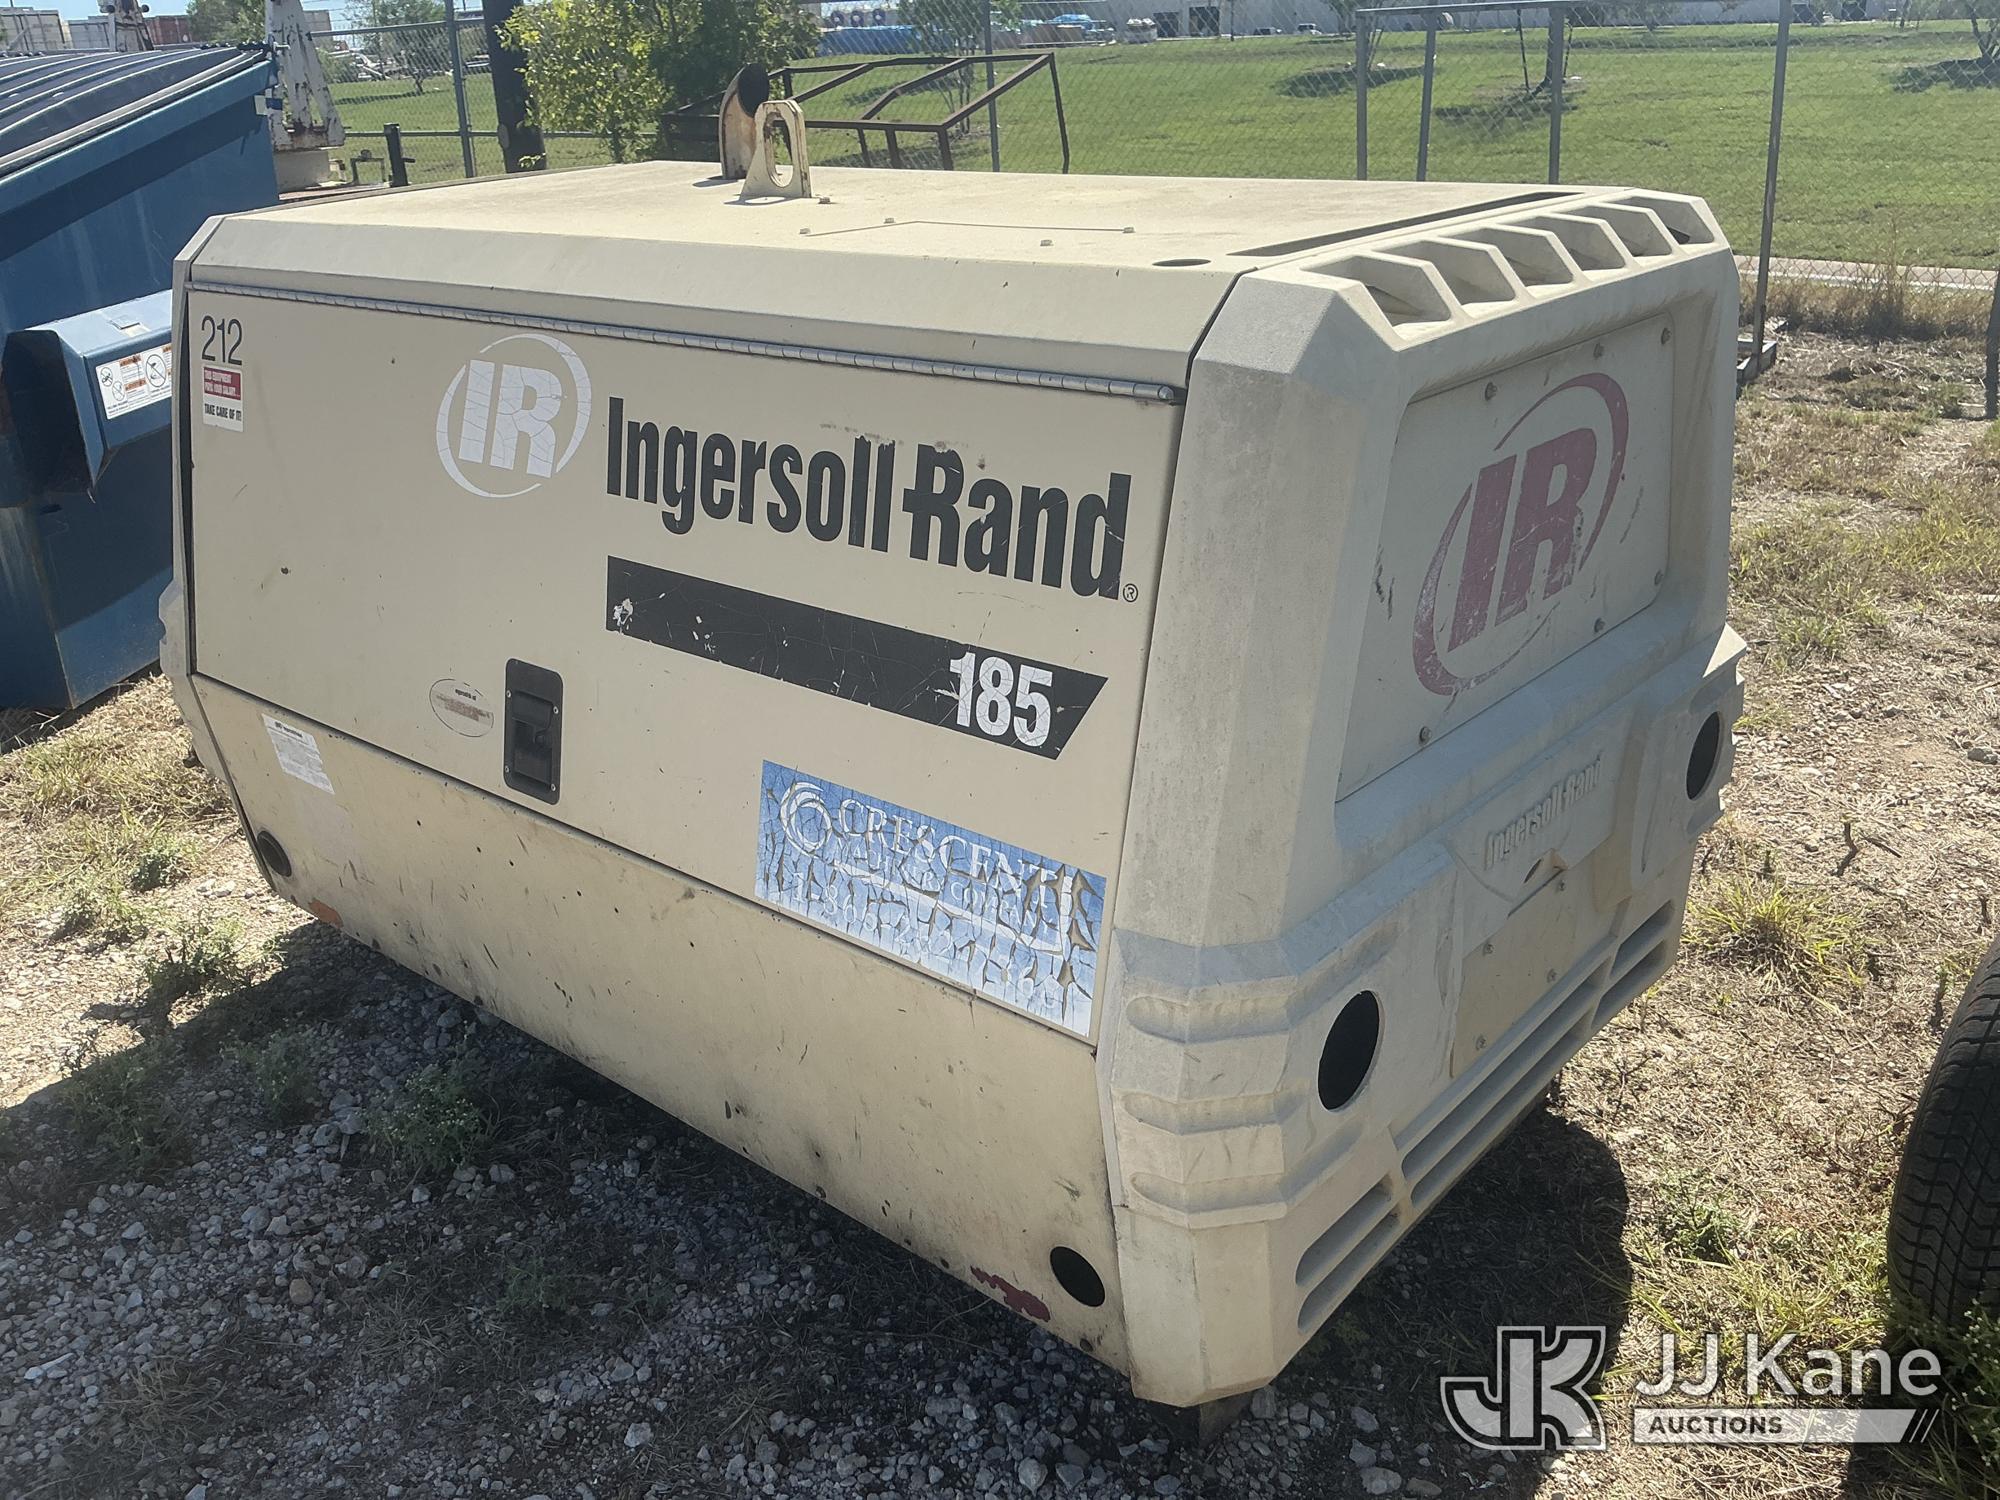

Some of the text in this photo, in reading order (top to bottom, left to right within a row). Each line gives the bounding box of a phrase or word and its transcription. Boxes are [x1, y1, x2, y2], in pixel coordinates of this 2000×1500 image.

[201, 315, 243, 366] 212
[459, 359, 564, 479] IR
[1448, 428, 1597, 652] IR
[949, 652, 1053, 747] 185
[839, 799, 1058, 909] CRESCENT
